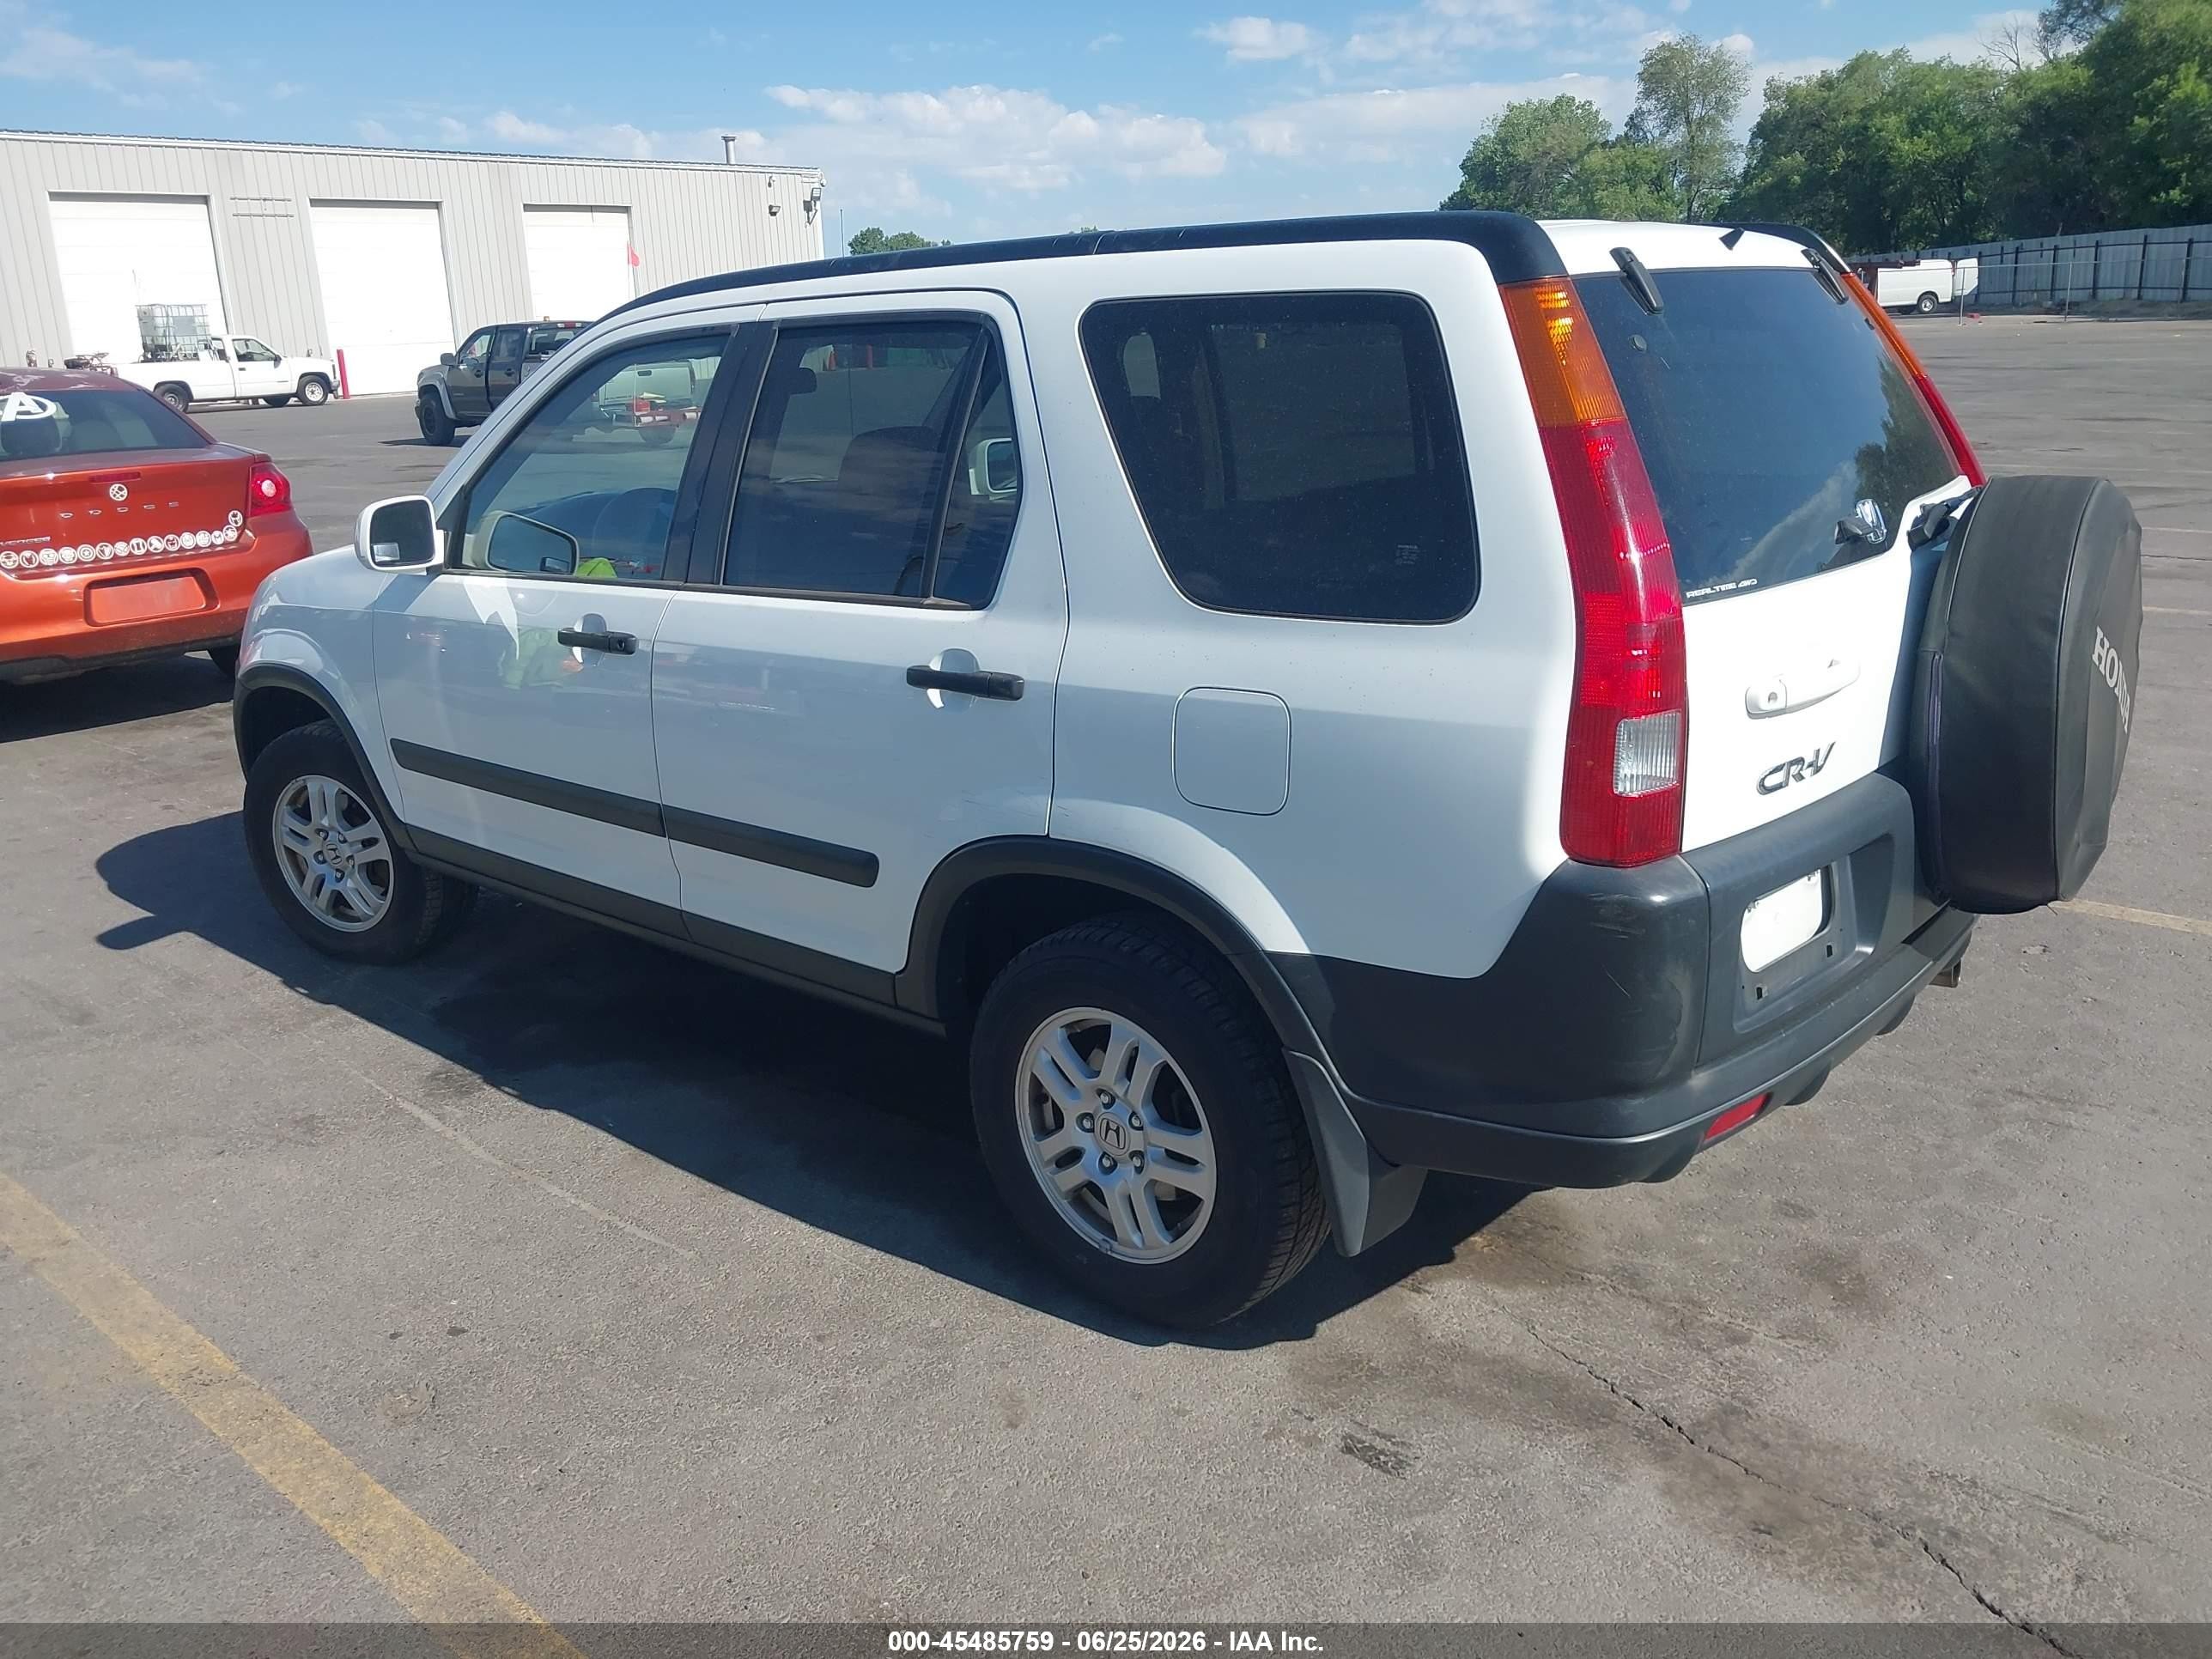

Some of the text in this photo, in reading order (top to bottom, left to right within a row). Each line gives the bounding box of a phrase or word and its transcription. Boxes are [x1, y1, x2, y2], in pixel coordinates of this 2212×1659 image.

[59, 501, 179, 519] DODGE
[2092, 625, 2130, 734] HONDA
[1756, 740, 1837, 795] CR-V
